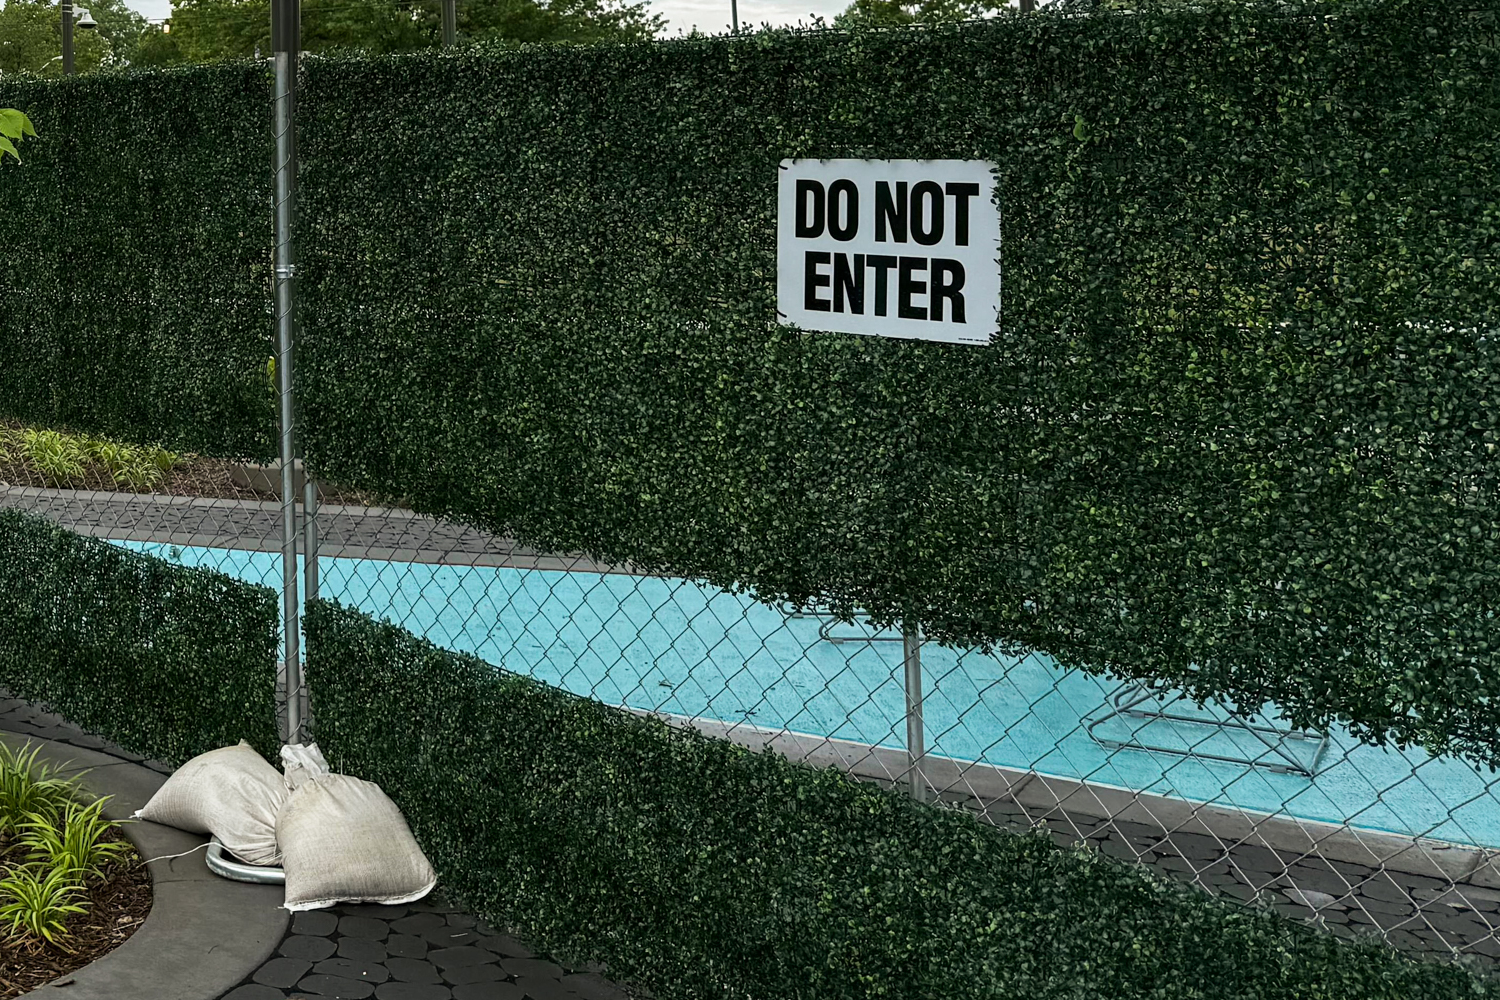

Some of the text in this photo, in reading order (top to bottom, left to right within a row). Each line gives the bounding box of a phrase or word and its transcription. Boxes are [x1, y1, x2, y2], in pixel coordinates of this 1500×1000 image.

[795, 178, 980, 247] DO NOT
[804, 250, 967, 324] ENTER
